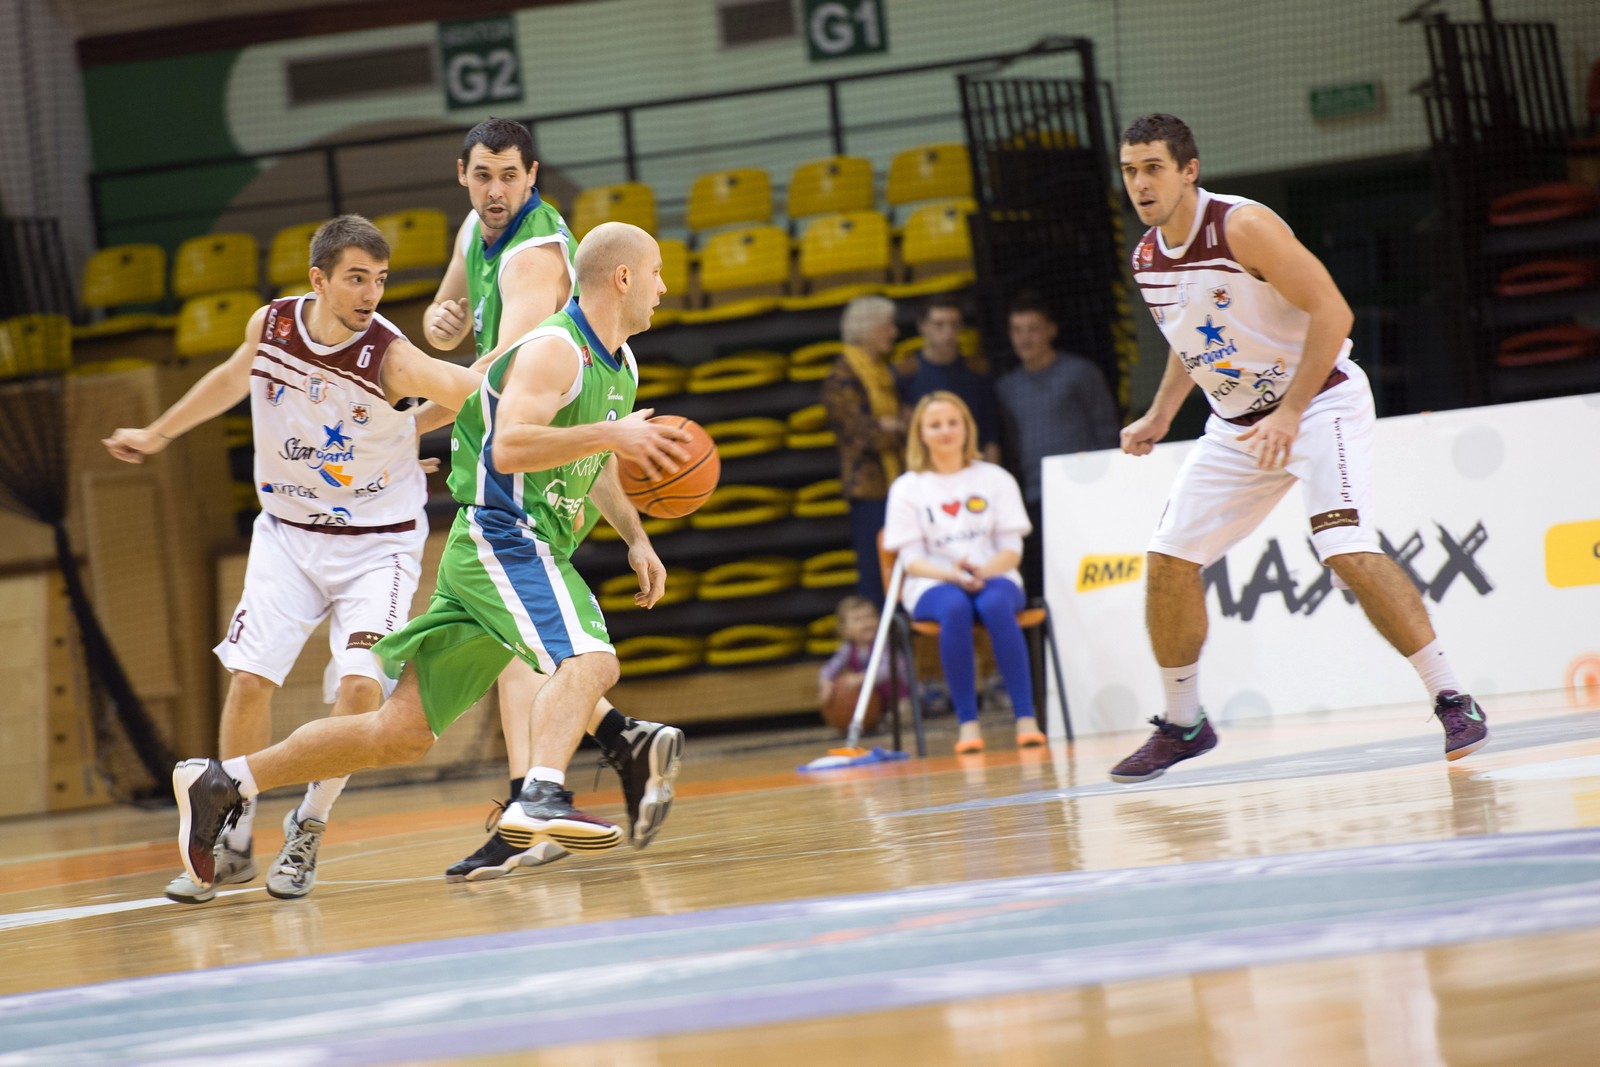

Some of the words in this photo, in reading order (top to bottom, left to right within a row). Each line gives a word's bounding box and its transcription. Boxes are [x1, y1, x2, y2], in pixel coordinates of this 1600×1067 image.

[811, 0, 880, 53] G1
[448, 49, 518, 103] G2
[356, 344, 376, 369] 6
[1082, 556, 1141, 587] RMF
